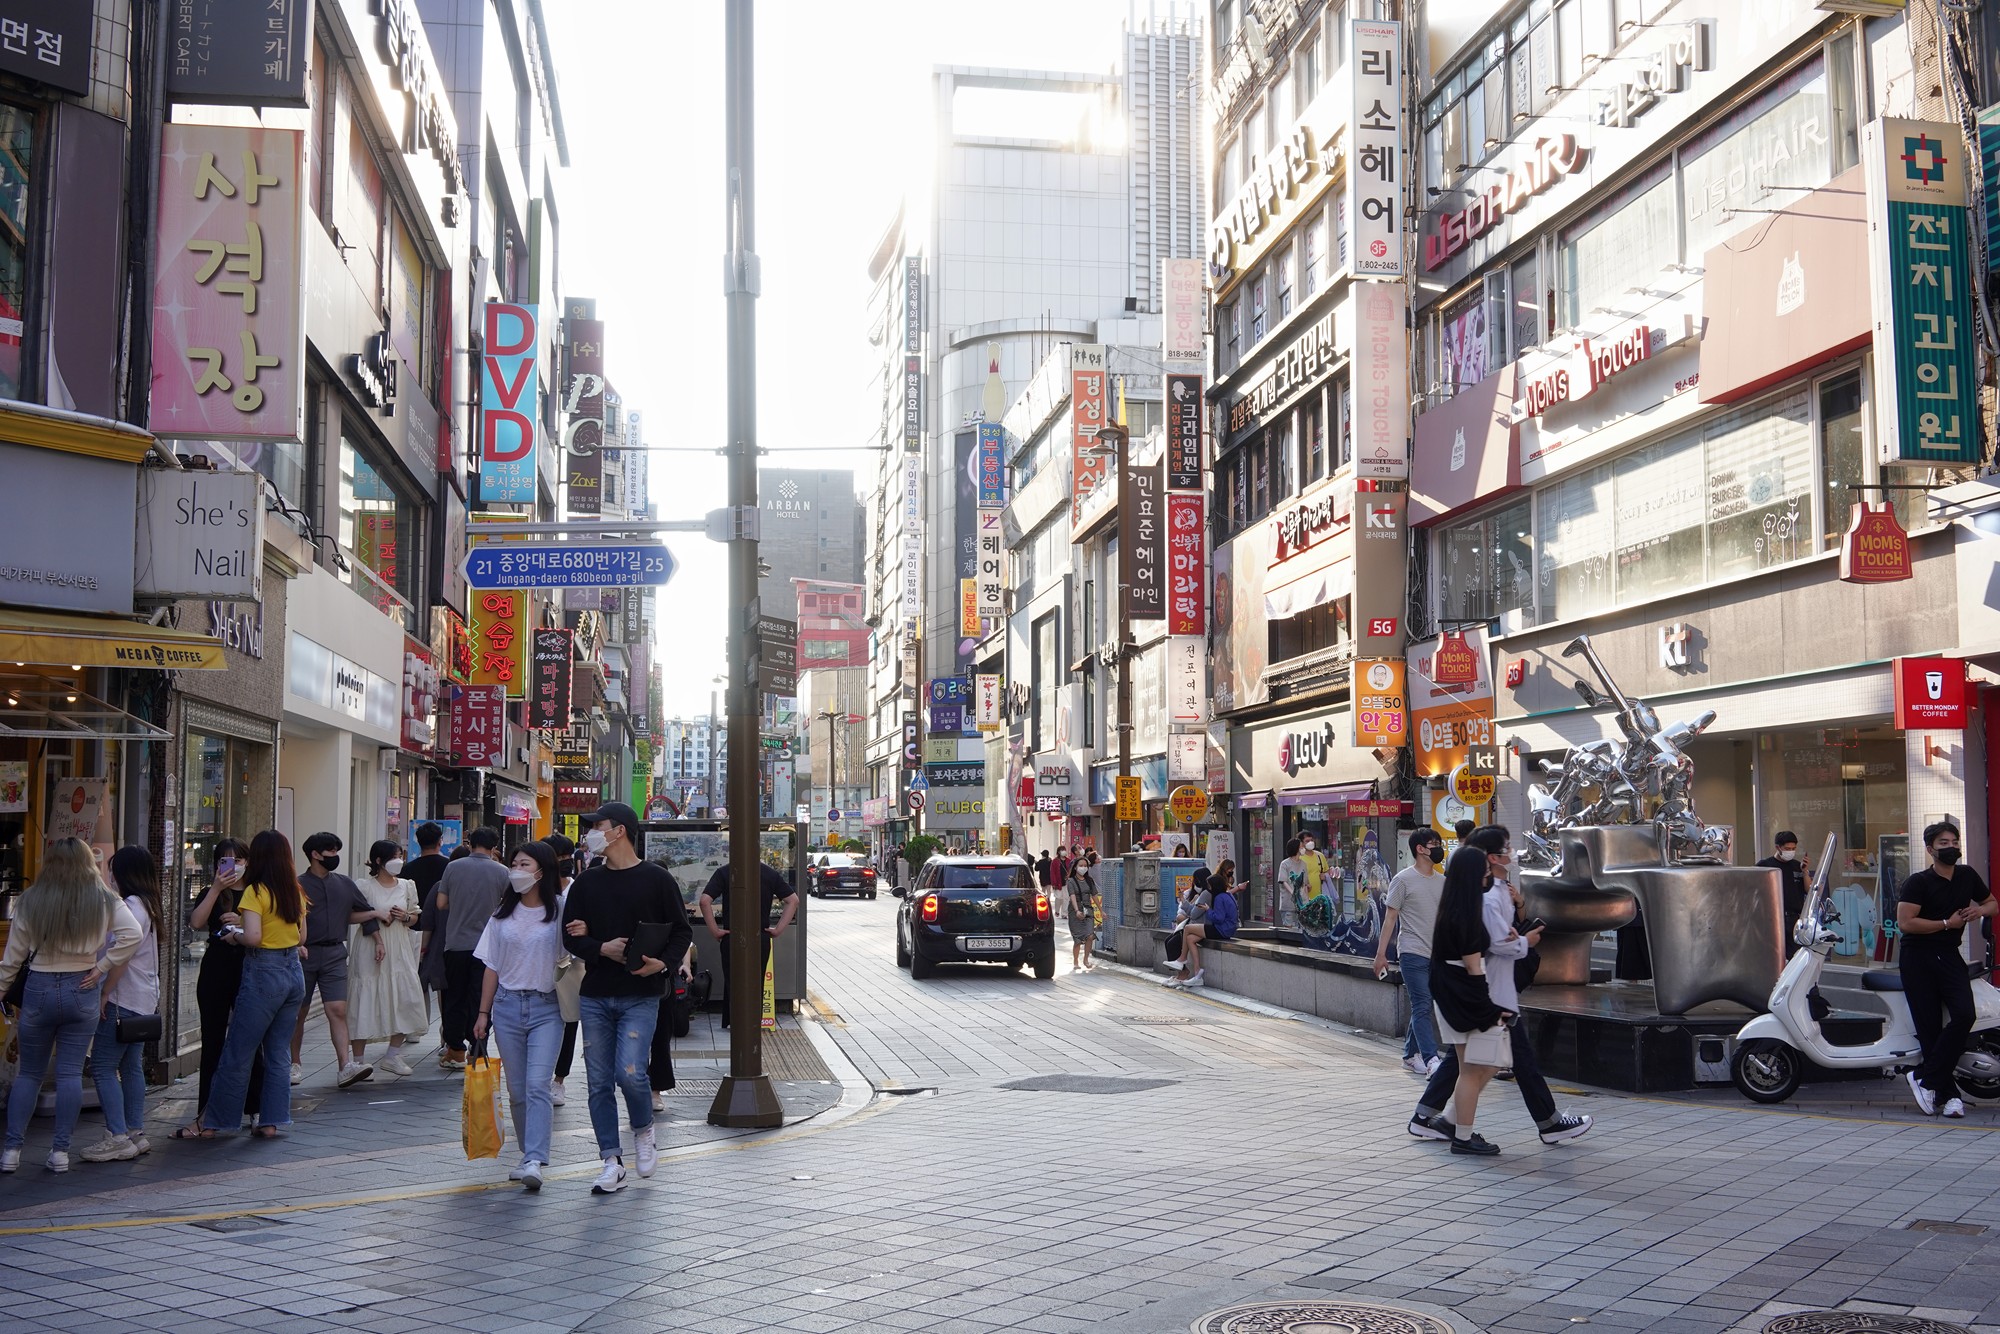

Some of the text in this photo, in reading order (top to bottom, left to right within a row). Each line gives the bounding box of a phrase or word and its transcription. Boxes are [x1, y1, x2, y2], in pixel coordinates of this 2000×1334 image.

[176, 37, 192, 76] CAFE
[1359, 49, 1396, 234] 리소헤어
[1371, 243, 1387, 255] 3F
[186, 149, 280, 413] 사격장
[1175, 293, 1195, 349] 부동산
[1908, 212, 1962, 451] 전치과의원
[1168, 350, 1202, 358] 818-9947
[1275, 312, 1336, 398] 크라임씬
[1589, 325, 1651, 383] TOUCH
[484, 303, 536, 463] DVD
[1372, 385, 1391, 444] TOUCH
[981, 428, 1001, 437] 경성
[1077, 375, 1106, 492] 경성부동산
[1171, 403, 1183, 473] 리얼추리게임
[1182, 403, 1198, 473] 크라임씬
[907, 438, 917, 447] 7F
[496, 463, 521, 475] 극장
[981, 439, 1001, 490] 부동산
[484, 476, 533, 489] 동시상영
[1180, 476, 1191, 485] 3F
[499, 490, 516, 500] 3F
[907, 471, 917, 517] 이루미치과
[174, 480, 249, 528] She's
[766, 500, 811, 512] ARBAN
[776, 511, 800, 519] HOTEL
[1365, 502, 1396, 529] kt
[1365, 531, 1398, 541] 공식대리점
[194, 548, 247, 578] Nail
[476, 560, 492, 575] 21
[499, 551, 642, 573] 중앙대로680번가길
[645, 557, 664, 572] 25
[1857, 551, 1903, 567] TOUCH
[982, 536, 1002, 602] 헤어짱
[0, 566, 99, 591] 메가커피 부산서면점
[496, 572, 644, 586] Jungang-daero 680beon ga-gil
[1173, 554, 1199, 619] 마라탕
[1132, 587, 1159, 604] 마인
[965, 592, 977, 630] 부동산
[1179, 621, 1194, 632] 2F
[1373, 620, 1392, 634] 5G
[1658, 622, 1692, 668] kt
[116, 647, 203, 663] MEGA COFFEE
[1185, 644, 1197, 710] 전포여관
[1441, 663, 1472, 674] TOUCH
[1507, 664, 1519, 682] 5G
[541, 662, 560, 717] 마라탕
[341, 692, 358, 710] BOX
[1360, 697, 1401, 710] 으뜸50
[1911, 704, 1959, 712] BETTER MONDAY
[1359, 711, 1403, 733] 안경
[1922, 710, 1948, 718] COFFEE
[453, 705, 463, 745] 폰케이스
[466, 689, 487, 761] 폰사랑
[491, 705, 501, 746] 필름부착
[542, 719, 555, 728] 2F
[632, 762, 647, 770] ABC
[1475, 752, 1495, 769] kt
[1457, 777, 1492, 795] 부동산
[935, 801, 970, 814] CLUB
[1173, 797, 1206, 809] 부동산
[1379, 803, 1399, 814] TOUCH
[988, 939, 1008, 949] 3555
